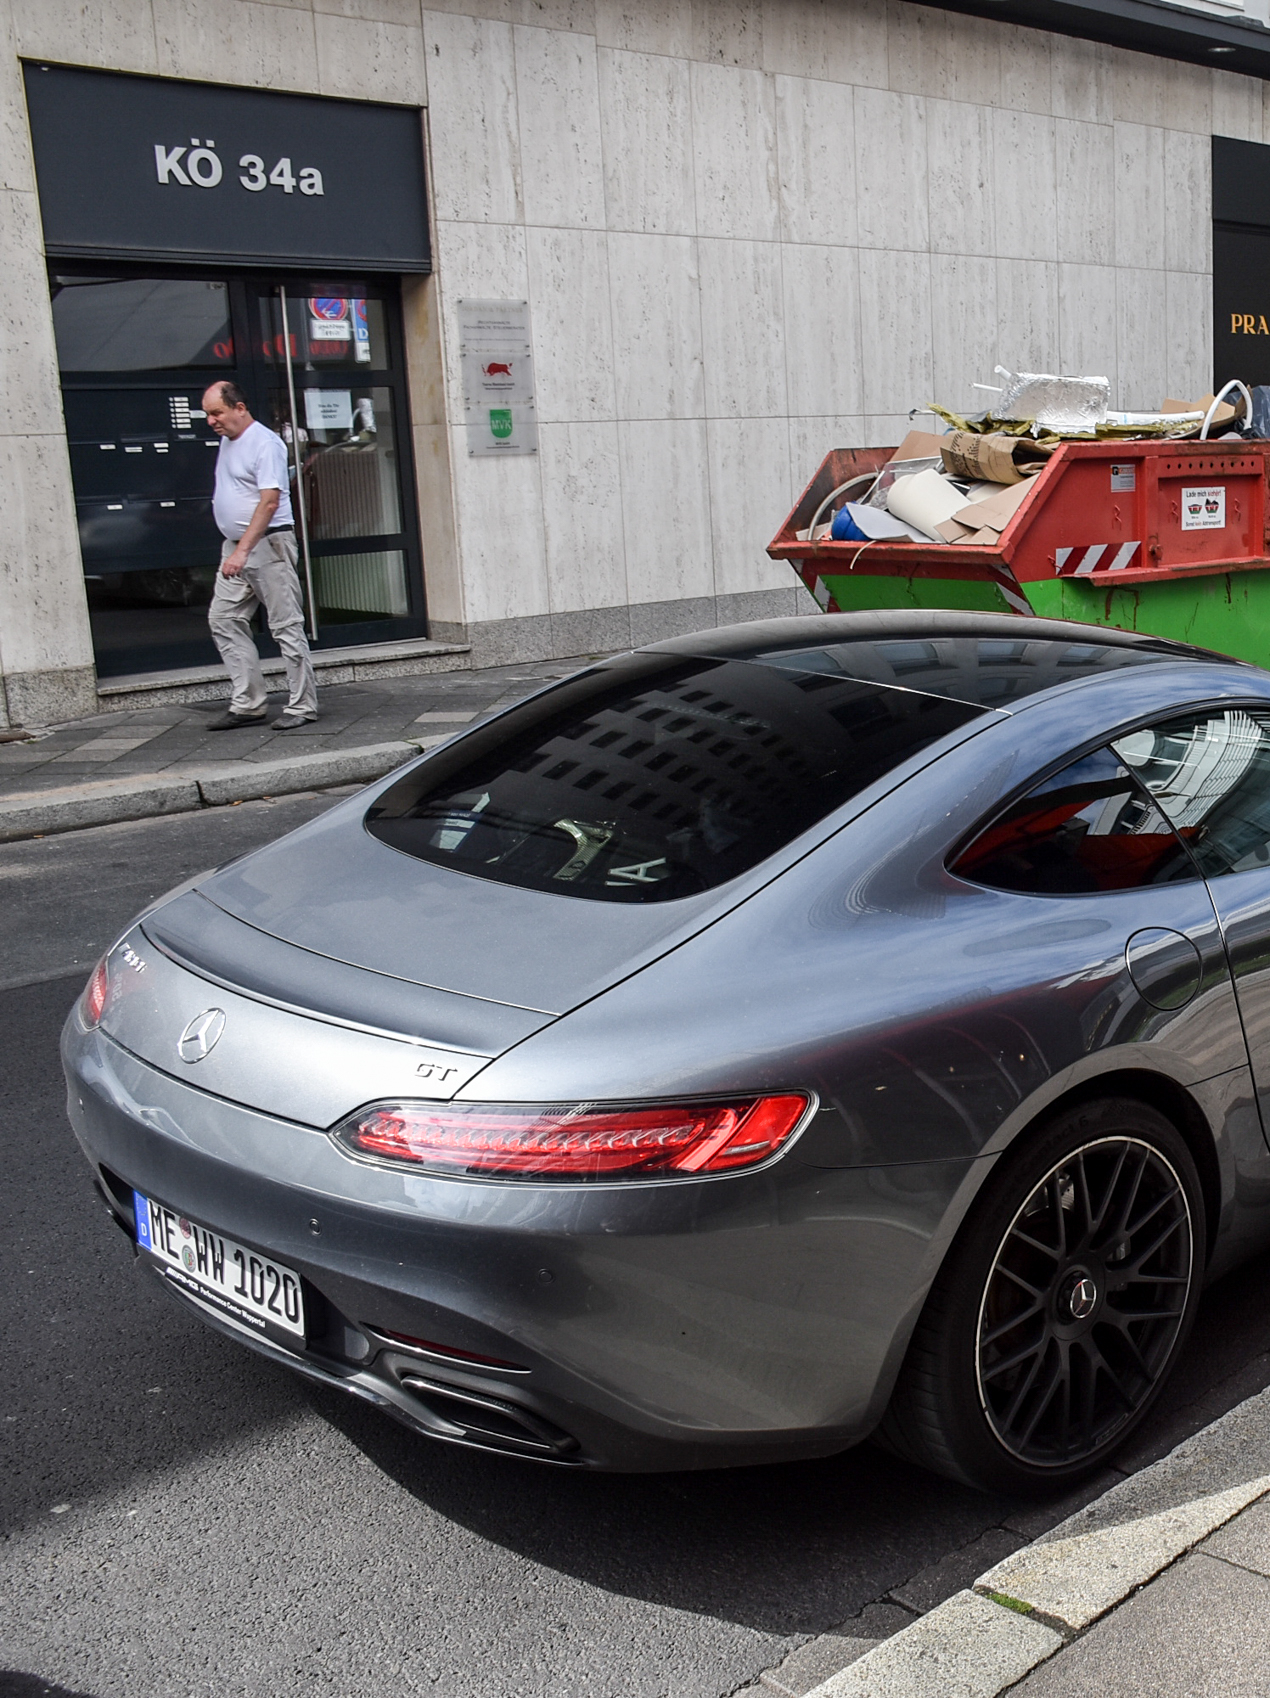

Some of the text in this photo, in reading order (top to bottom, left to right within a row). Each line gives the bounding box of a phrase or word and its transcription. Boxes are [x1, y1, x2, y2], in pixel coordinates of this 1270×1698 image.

[154, 138, 325, 195] KÖ 34a
[491, 420, 511, 430] MVK
[150, 1200, 180, 1260] ME
[193, 1226, 225, 1285] WW
[234, 1249, 300, 1324] 1020
[200, 1286, 228, 1307] Performance
[227, 1302, 242, 1315] Center
[242, 1309, 266, 1328] Wuppertal
